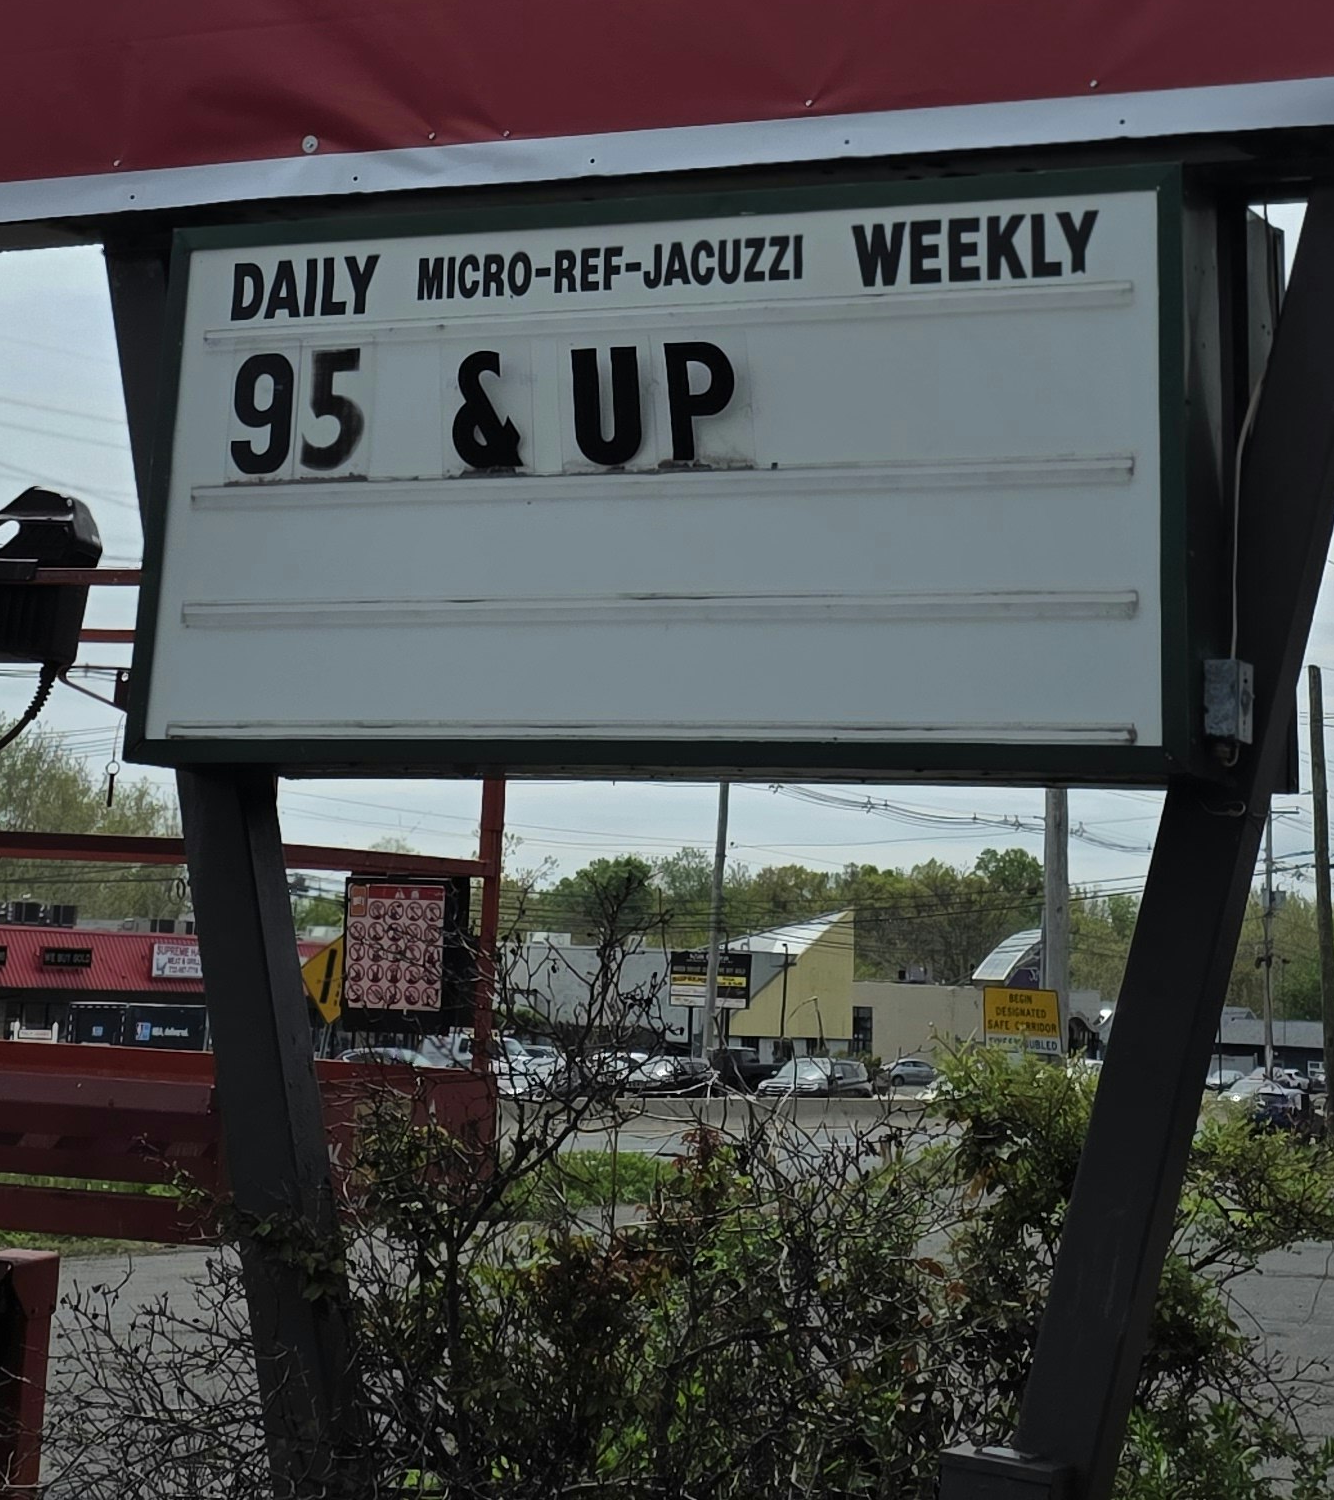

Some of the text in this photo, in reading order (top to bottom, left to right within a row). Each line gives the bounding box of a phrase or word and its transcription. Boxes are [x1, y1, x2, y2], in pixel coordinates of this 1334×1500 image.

[229, 208, 1101, 322] DAILY MICRO-REF-JACUZZI WEEKLY
[229, 340, 736, 476] 95 & UP
[157, 945, 190, 957] SUPREME
[1008, 993, 1033, 1005] BEGIN
[995, 1006, 1047, 1019] DESIGNATED
[987, 1019, 1010, 1031] SAFE
